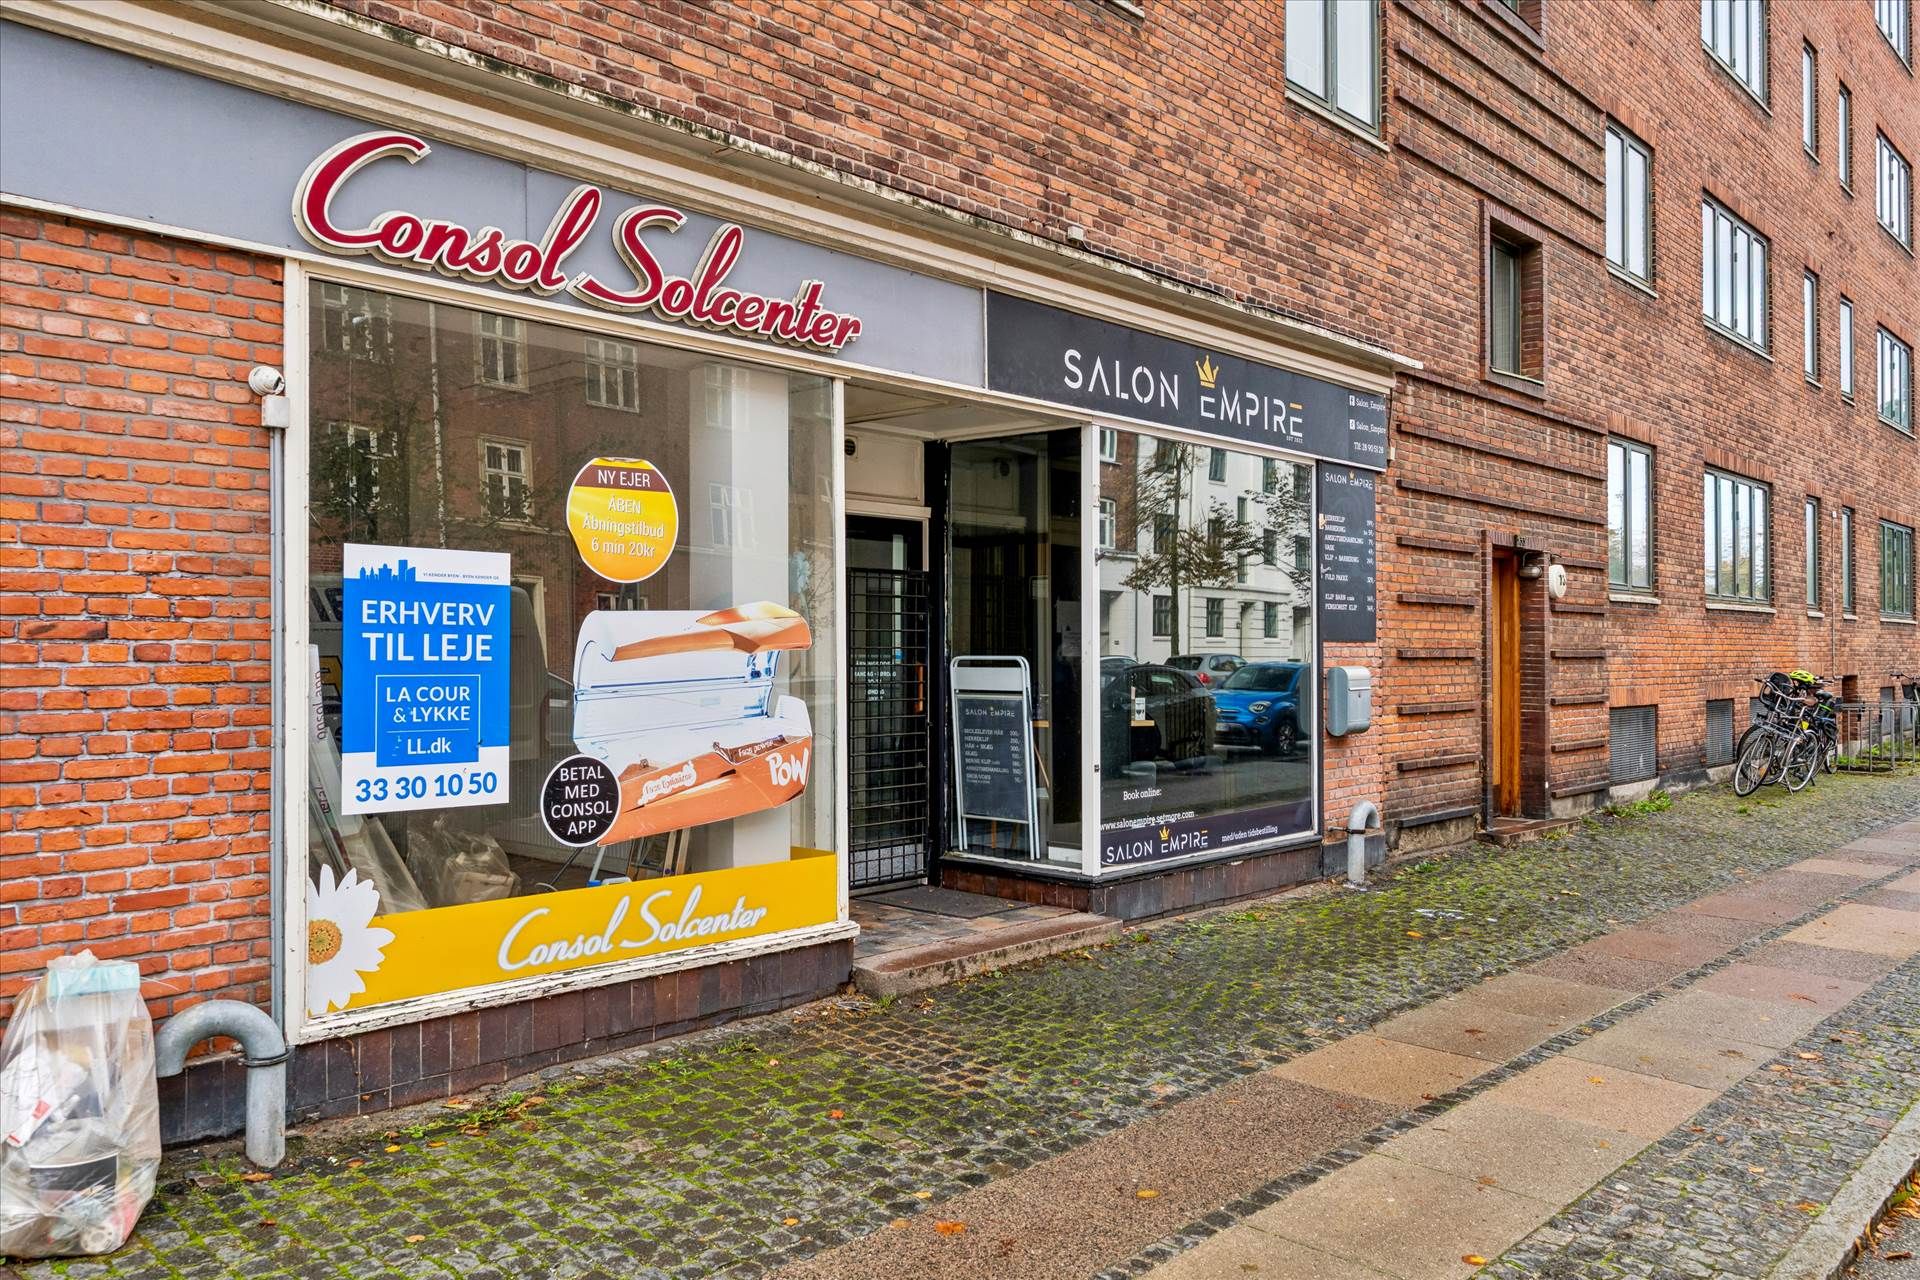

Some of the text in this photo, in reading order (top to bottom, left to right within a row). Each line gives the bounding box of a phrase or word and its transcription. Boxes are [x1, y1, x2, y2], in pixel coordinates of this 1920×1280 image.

[294, 131, 862, 349] Consol Solcenter
[1064, 349, 1304, 438] SALON EMPIRE
[598, 470, 651, 487] NY EJER
[1325, 472, 1373, 490] SALON EMPIRE
[608, 496, 641, 514] ÅBEN
[582, 513, 664, 538] Åbningstilbud
[591, 537, 655, 557] 6 min 20kr
[362, 599, 495, 626] ERHVERV
[362, 633, 493, 661] TIL LEJE
[386, 686, 471, 702] LA COUR
[393, 706, 471, 723] & LYKKE
[965, 708, 988, 716] SALON
[407, 737, 452, 755] LL.dk
[560, 766, 605, 781] BETAL
[355, 778, 388, 802] 33
[395, 776, 427, 799] 30
[434, 773, 463, 797] 10
[468, 772, 497, 795] 50
[565, 784, 600, 799] MED
[1123, 788, 1162, 800] Book online:
[551, 800, 613, 818] CONSOL
[567, 820, 597, 836] APP
[1106, 839, 1153, 863] SALON
[1162, 831, 1208, 854] EMPIRE
[498, 885, 767, 971] Consol Solcenter
